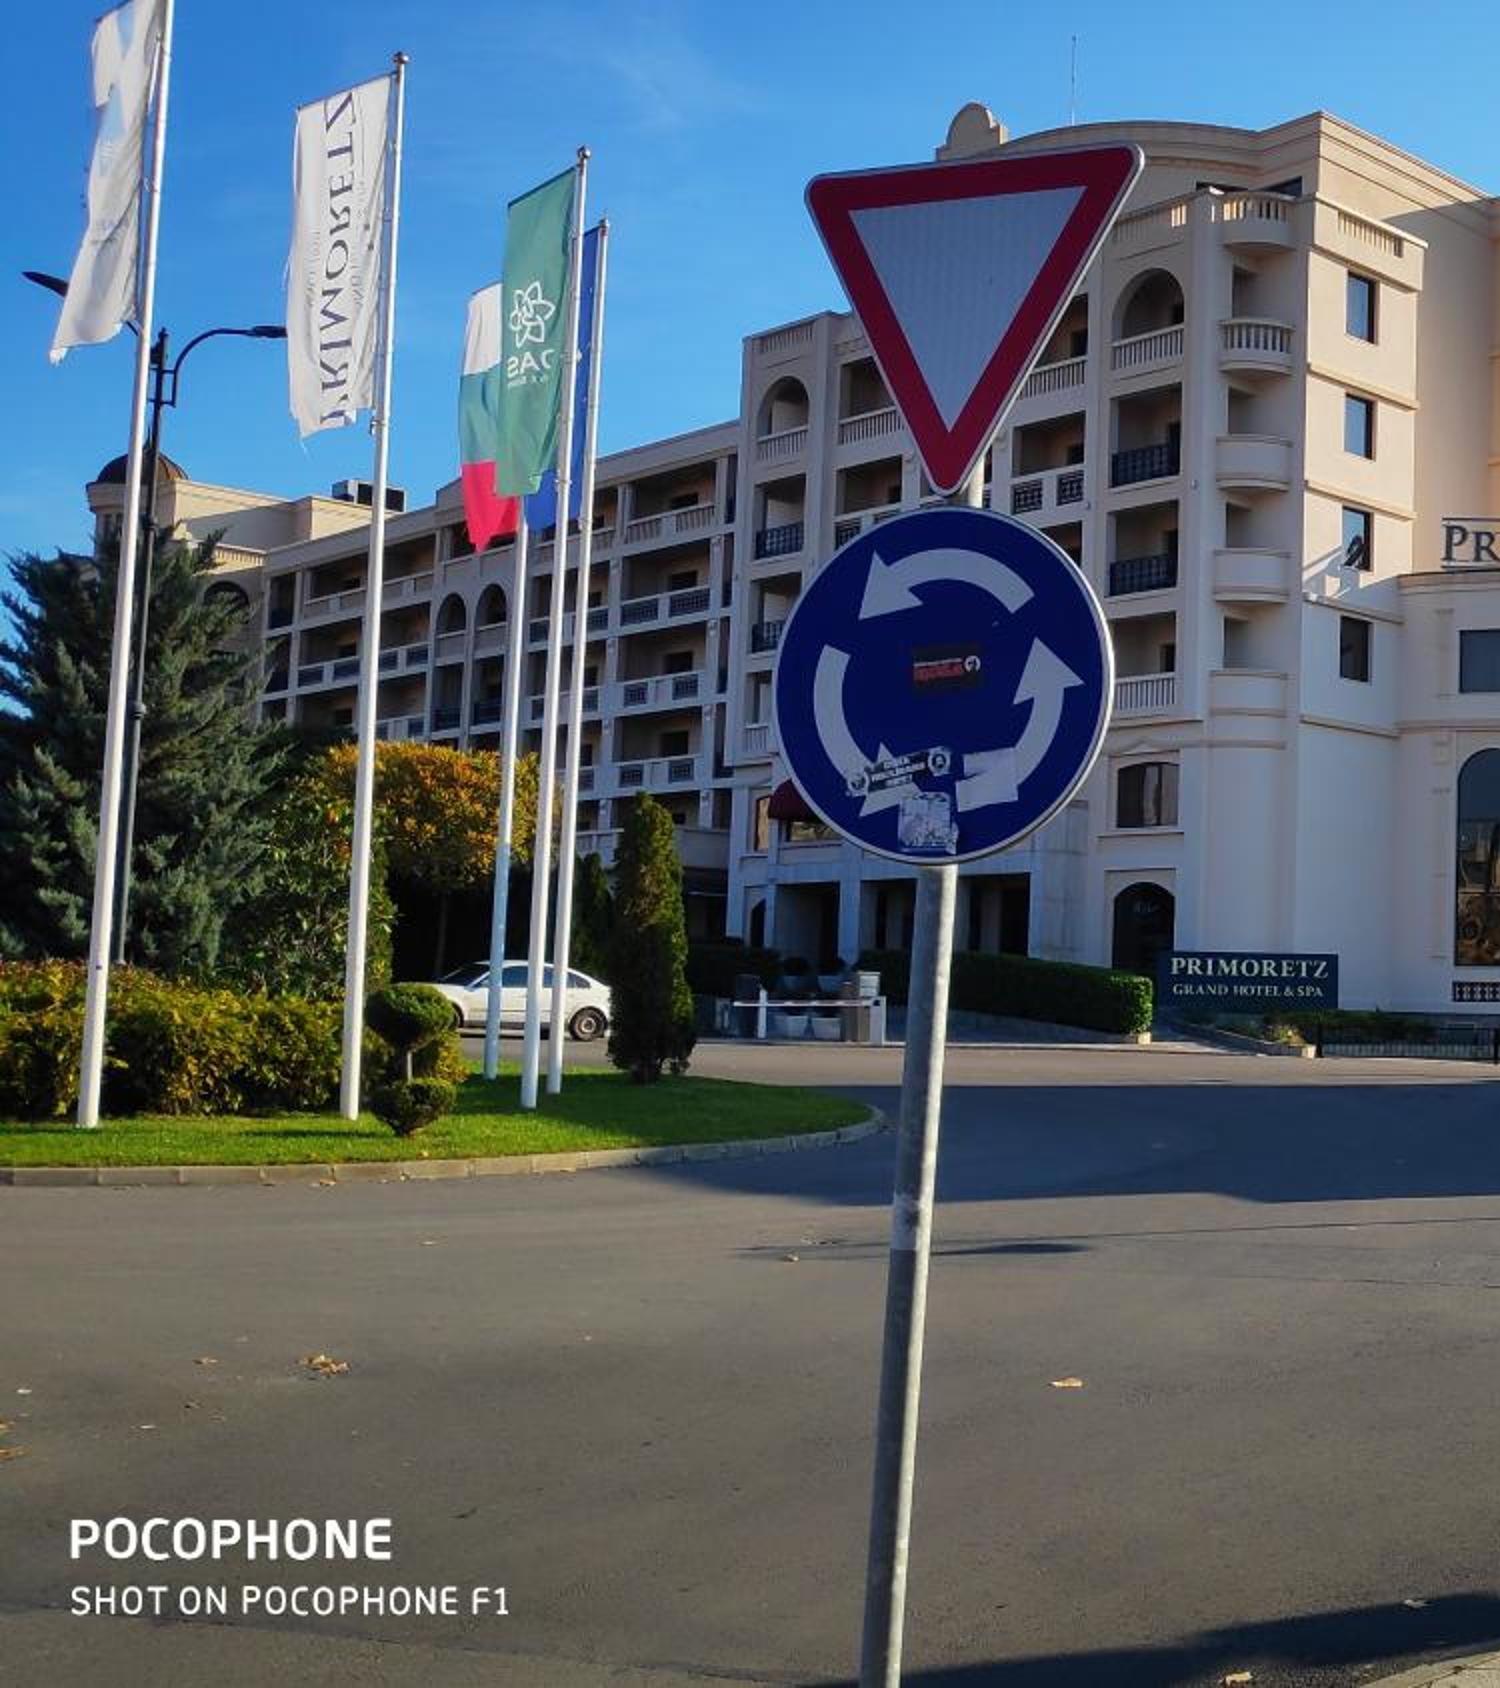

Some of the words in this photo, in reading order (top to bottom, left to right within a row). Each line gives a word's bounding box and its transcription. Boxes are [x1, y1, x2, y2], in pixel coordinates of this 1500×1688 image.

[1170, 957, 1328, 978] PRIMORETZ
[1173, 983, 1229, 996] GRAND
[1233, 985, 1280, 997] HOTEL
[1283, 986, 1294, 997] &
[1297, 986, 1323, 997] SPA
